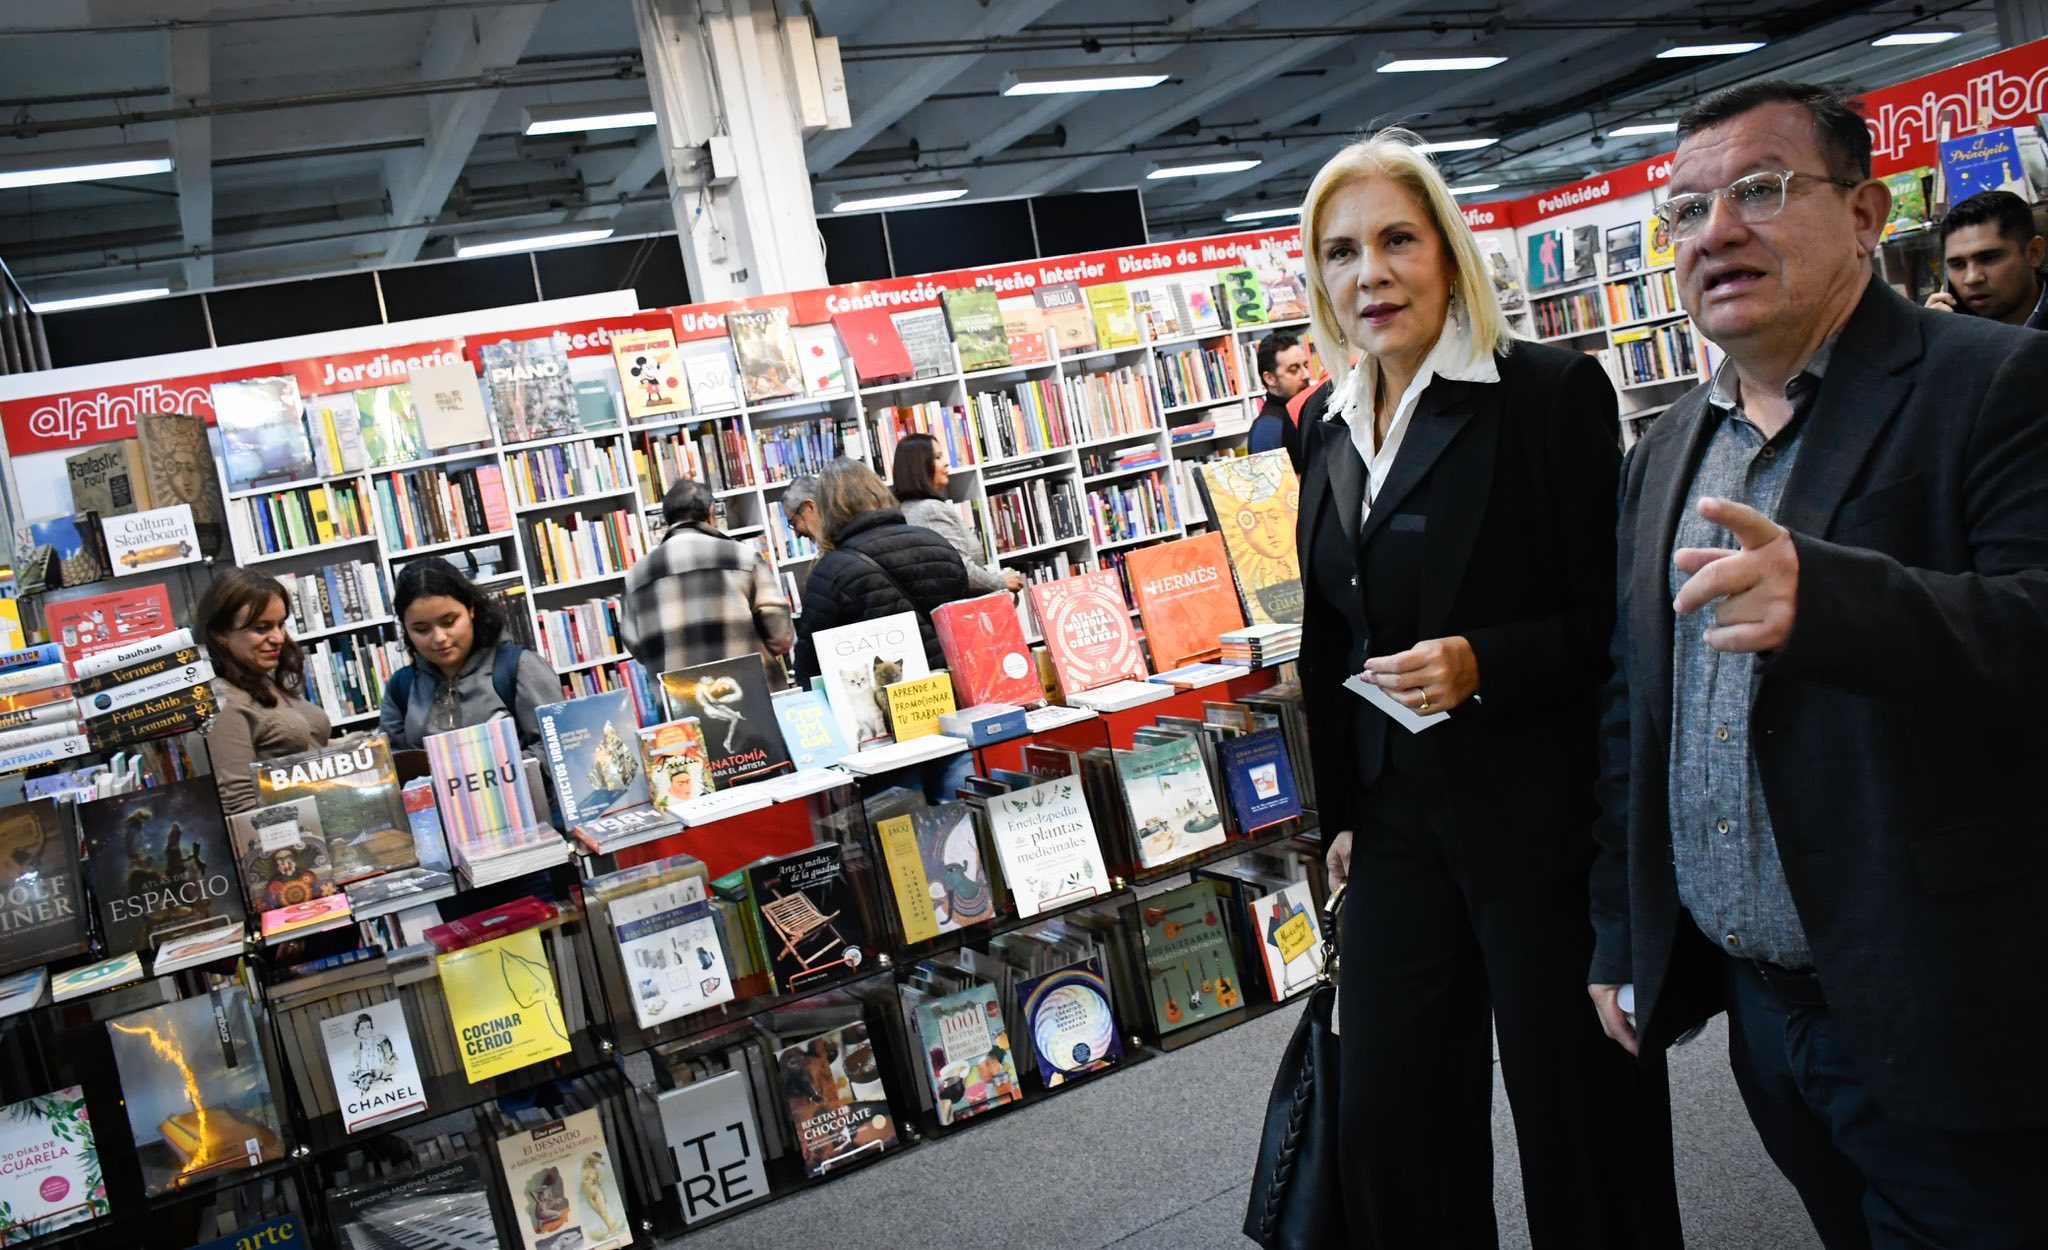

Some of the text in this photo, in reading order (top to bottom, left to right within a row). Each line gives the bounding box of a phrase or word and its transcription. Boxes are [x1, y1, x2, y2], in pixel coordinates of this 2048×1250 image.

[1947, 142, 2009, 165] Principito
[1972, 138, 1984, 150] El
[1538, 180, 1610, 213] Publicidad
[1260, 235, 1300, 251] Diseñ
[1117, 252, 1172, 273] Diseño
[1176, 249, 1198, 265] de
[975, 261, 1105, 292] Diseño Interior
[1043, 292, 1075, 307] DIBUJO
[491, 361, 560, 384] PIANO
[29, 384, 214, 440] alfinlibr
[114, 525, 189, 548] Skateboard
[124, 516, 175, 533] Cultura
[1149, 565, 1218, 595] HERMÈS
[316, 577, 331, 613] ANDO
[1064, 614, 1115, 633] MUNDIAL
[1070, 608, 1105, 623] ATLAS
[836, 630, 904, 656] GATO
[1069, 630, 1120, 649] CERVEZA
[1075, 624, 1109, 639] DE LA
[117, 643, 162, 662] bauhaus
[112, 659, 166, 683] Vermeer
[115, 690, 137, 701] LIVING
[147, 676, 181, 692] MOROCCO
[892, 683, 938, 698] APRENDE A
[112, 696, 181, 725] Frida Kahlo
[895, 692, 951, 713] PROMOCIONAR
[131, 713, 188, 736] Leonardo
[897, 708, 945, 725] TU TRABAJO
[541, 715, 563, 763] URBANOS
[270, 742, 374, 791] BAMBÚ
[447, 760, 517, 797] PERÚ
[711, 760, 767, 778] ARA EL ARTISTA
[554, 762, 580, 821] PROYECTOS
[584, 809, 662, 832] 1984
[1007, 804, 1079, 832] Enciclopedia
[1015, 820, 1084, 846] de plantas
[1017, 836, 1087, 864] medicinales
[780, 863, 796, 875] Arte
[790, 873, 800, 882] de
[801, 869, 809, 880] la
[810, 861, 840, 879] guadua
[108, 875, 229, 922] ESPACIO
[215, 1006, 230, 1043] croquis
[462, 1013, 522, 1041] COCINAR
[945, 1010, 980, 1034] 1001
[466, 1030, 513, 1056] CERDO
[348, 1086, 417, 1114] CHANEL
[801, 1111, 836, 1130] RECETAS
[803, 1107, 871, 1141] CHOCOLATE
[2, 1140, 55, 1162] 30 DÍAS DE
[534, 1130, 580, 1153] DESNUDO
[350, 1191, 390, 1208] Fernando
[427, 1165, 464, 1183] Sanabria
[235, 1222, 294, 1250] arte
